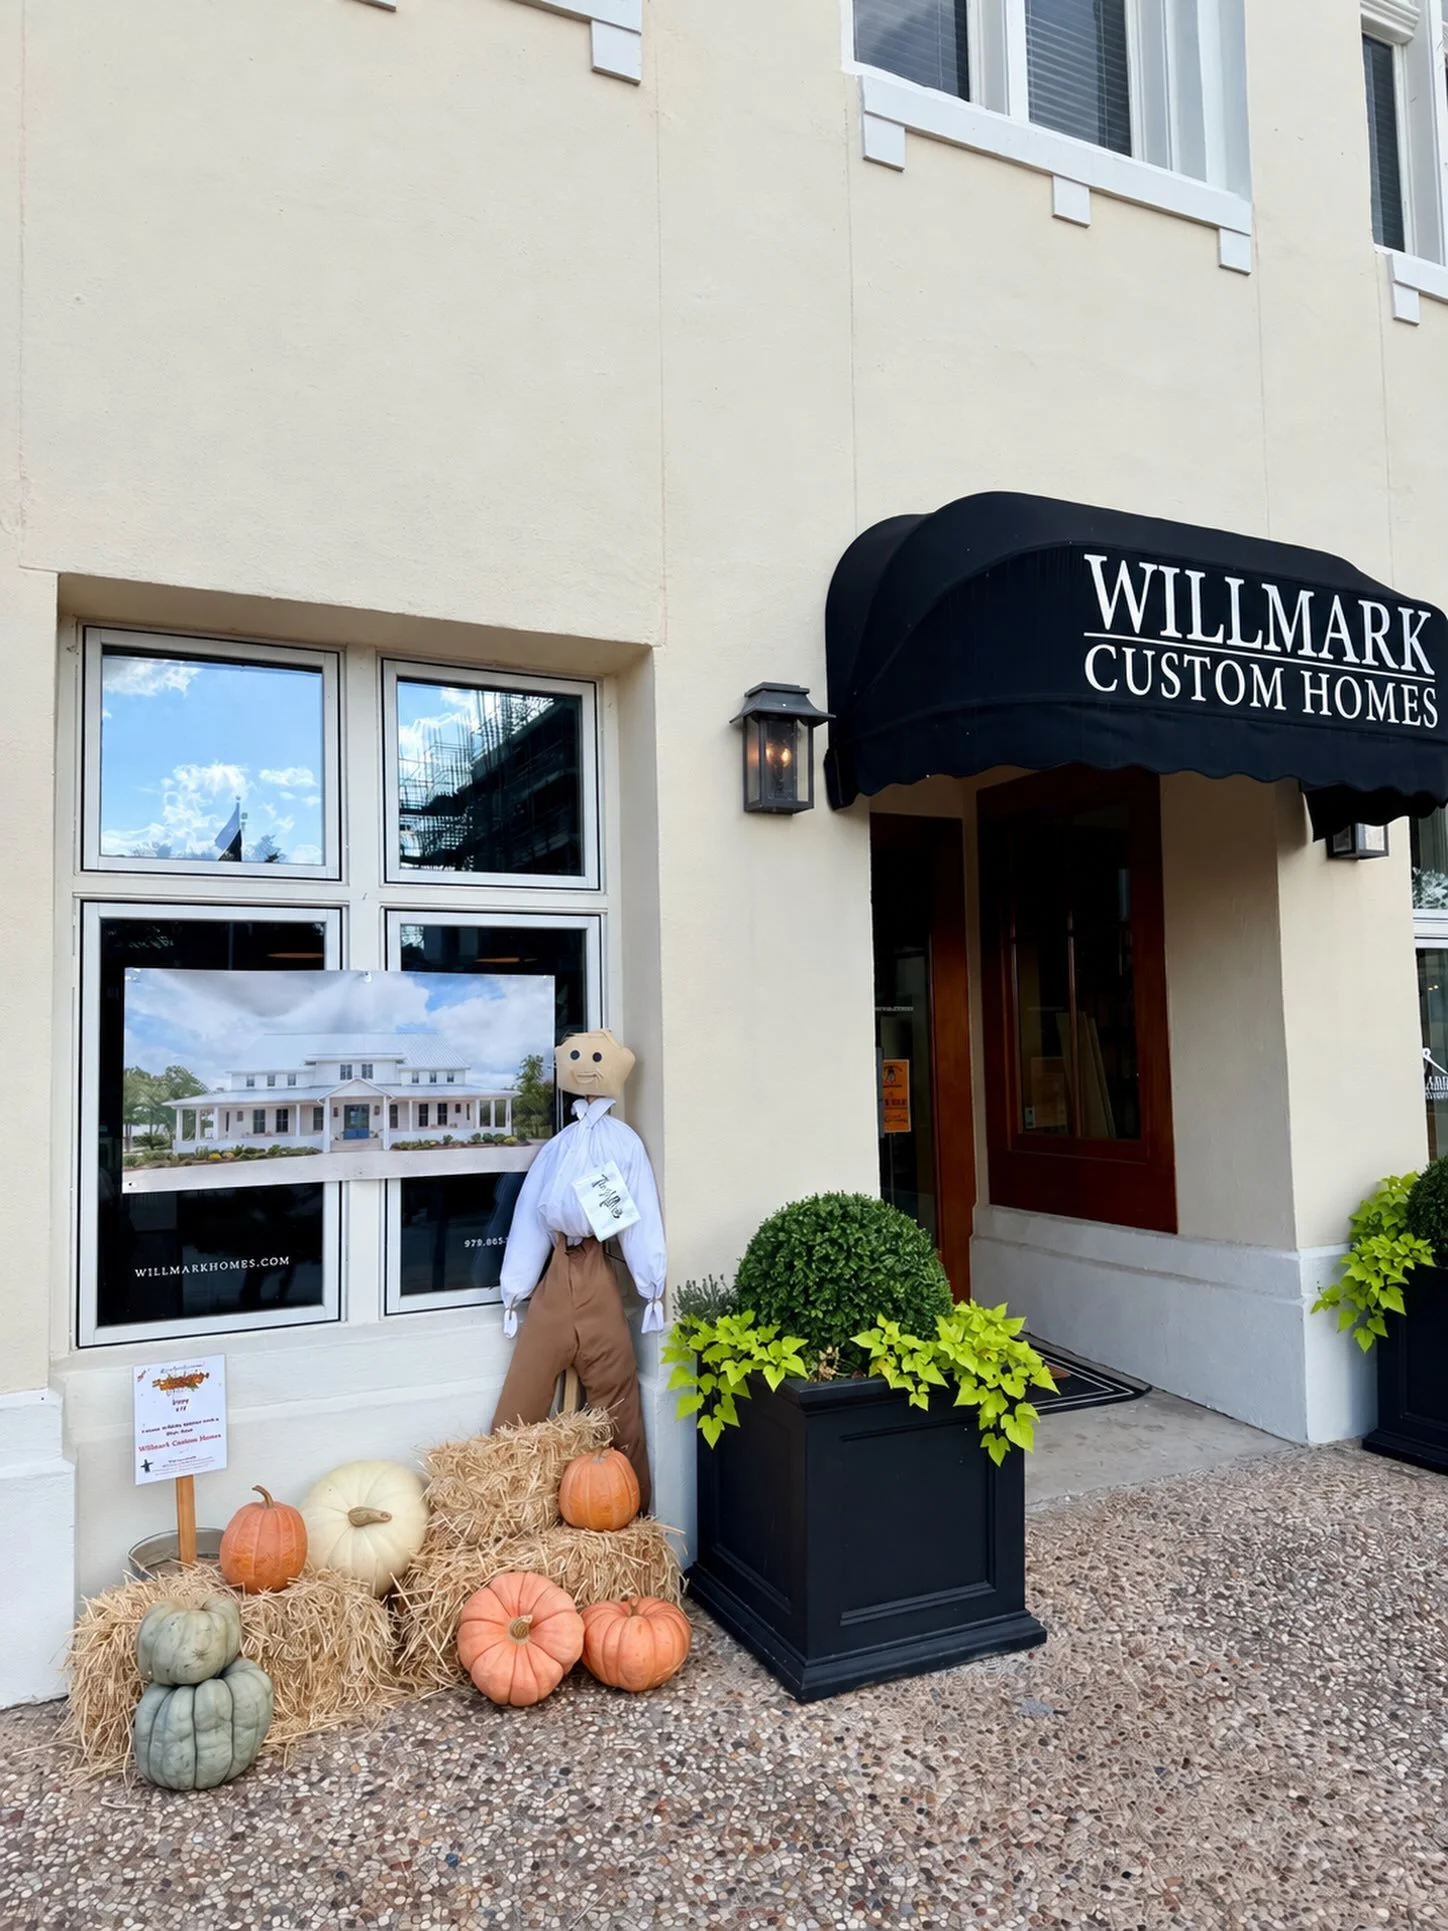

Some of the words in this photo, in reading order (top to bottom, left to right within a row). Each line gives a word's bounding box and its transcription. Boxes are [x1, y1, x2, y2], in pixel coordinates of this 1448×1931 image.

[1083, 553, 1436, 676] WILLMARK
[1084, 644, 1287, 711] CUSTOM
[1300, 670, 1438, 729] HOMES
[134, 1256, 290, 1278] WILLMARKHOMES.COM
